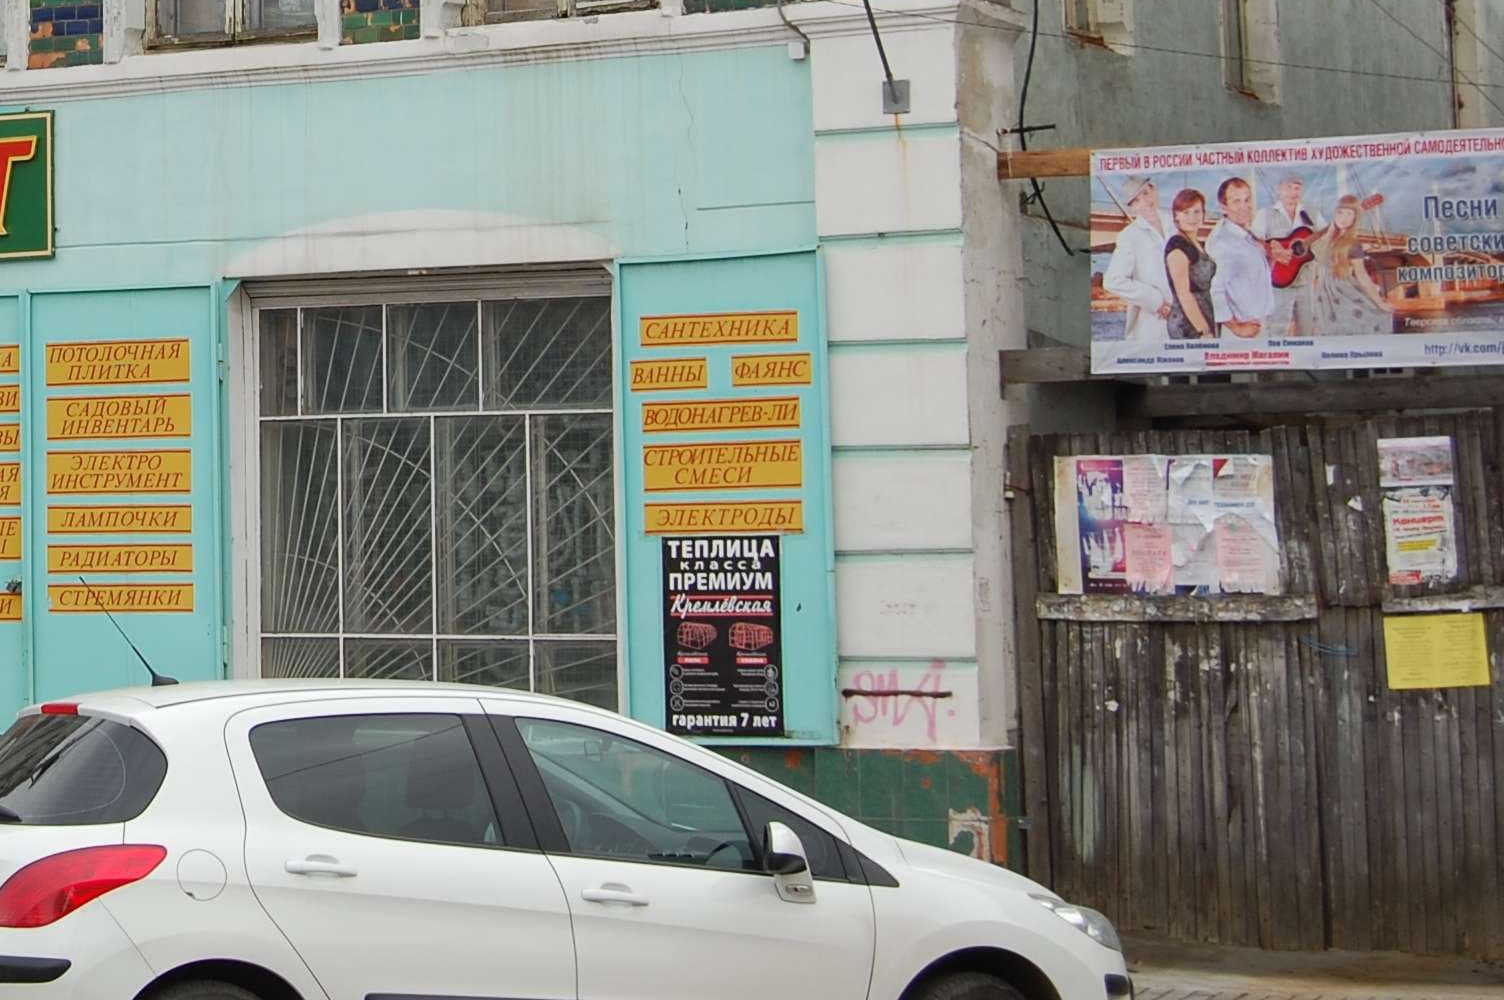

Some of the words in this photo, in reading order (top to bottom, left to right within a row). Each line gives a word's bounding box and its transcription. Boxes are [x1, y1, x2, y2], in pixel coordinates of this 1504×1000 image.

[1099, 153, 1141, 171] ПЕРВЫЙ
[1144, 157, 1150, 169] В
[1153, 154, 1193, 168] РОССИИ
[1196, 147, 1245, 166] ЧАСТНЫЙ
[1247, 147, 1308, 164] КОЛЛЕКТИВ
[1311, 139, 1411, 162] ХУДОЖЕСТВЕННОЙ
[1424, 195, 1497, 219] Песни
[645, 319, 791, 340] САНТЕХНИКА
[49, 342, 181, 364] ПОТОЛОЧНАЯ
[67, 363, 152, 381] ПЛИТКА
[632, 364, 704, 385] ВАННЫ
[735, 360, 807, 380] ФАЯНС
[65, 396, 167, 419] САДОВЫЙ
[644, 403, 798, 427] ВОДОНАГРЕВ-ЛИ
[61, 416, 176, 436] ИНВЕНТАРЬ
[71, 454, 163, 471] ЭЛЕКТРО
[643, 444, 799, 467] СТРОИТЕЛЬНЫЕ
[51, 471, 183, 490] ИНСТРУМЕНТ
[674, 466, 753, 485] СМЕСИ
[60, 510, 178, 528] ЛАМПОЧКИ
[656, 506, 795, 528] ЭЛЕКТРОДЫ
[59, 550, 177, 569] РАДИАТОРЫ
[667, 539, 775, 561] ТЕПЛИЦА
[680, 560, 762, 571] класса
[669, 572, 773, 591] ПРЕМИУМ
[59, 588, 182, 606] СТРЕМЯНКИ
[670, 593, 773, 619] Кремлёвская
[672, 715, 738, 730] гарантия
[741, 713, 749, 728] 7
[753, 716, 777, 728] лет
